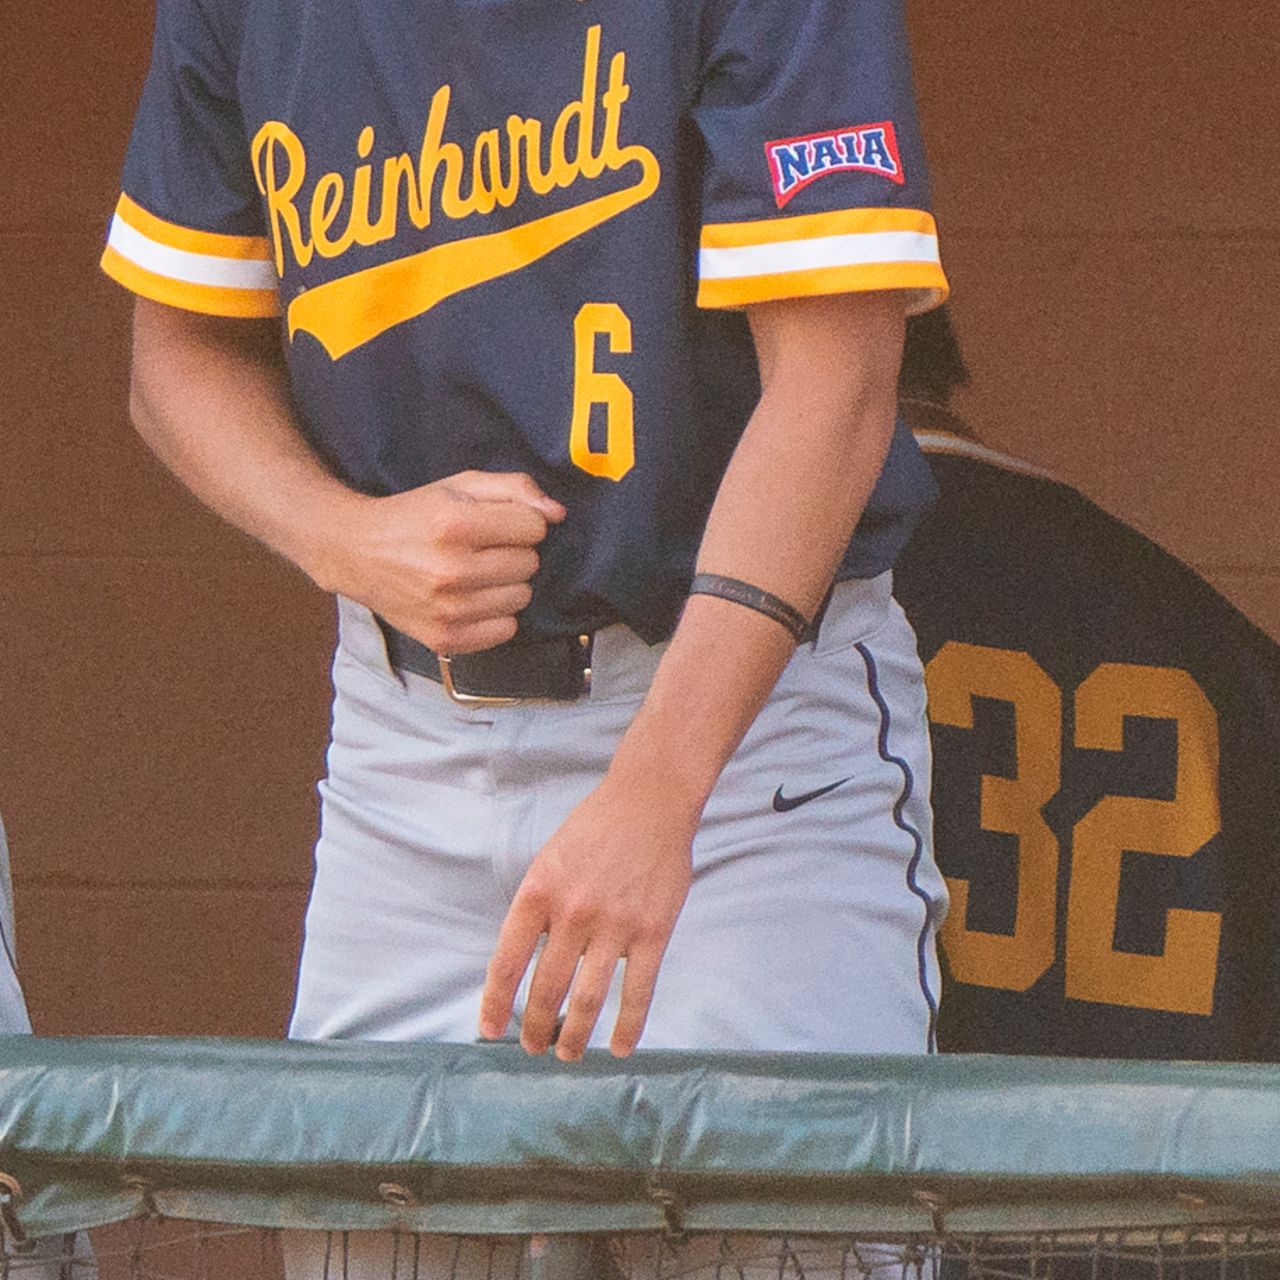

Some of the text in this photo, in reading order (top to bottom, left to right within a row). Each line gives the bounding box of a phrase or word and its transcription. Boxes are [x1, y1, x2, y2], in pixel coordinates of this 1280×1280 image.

[251, 24, 654, 278] Reinhardt
[777, 127, 897, 193] NAIA
[570, 303, 635, 482] 6
[925, 640, 1222, 1017] 32
